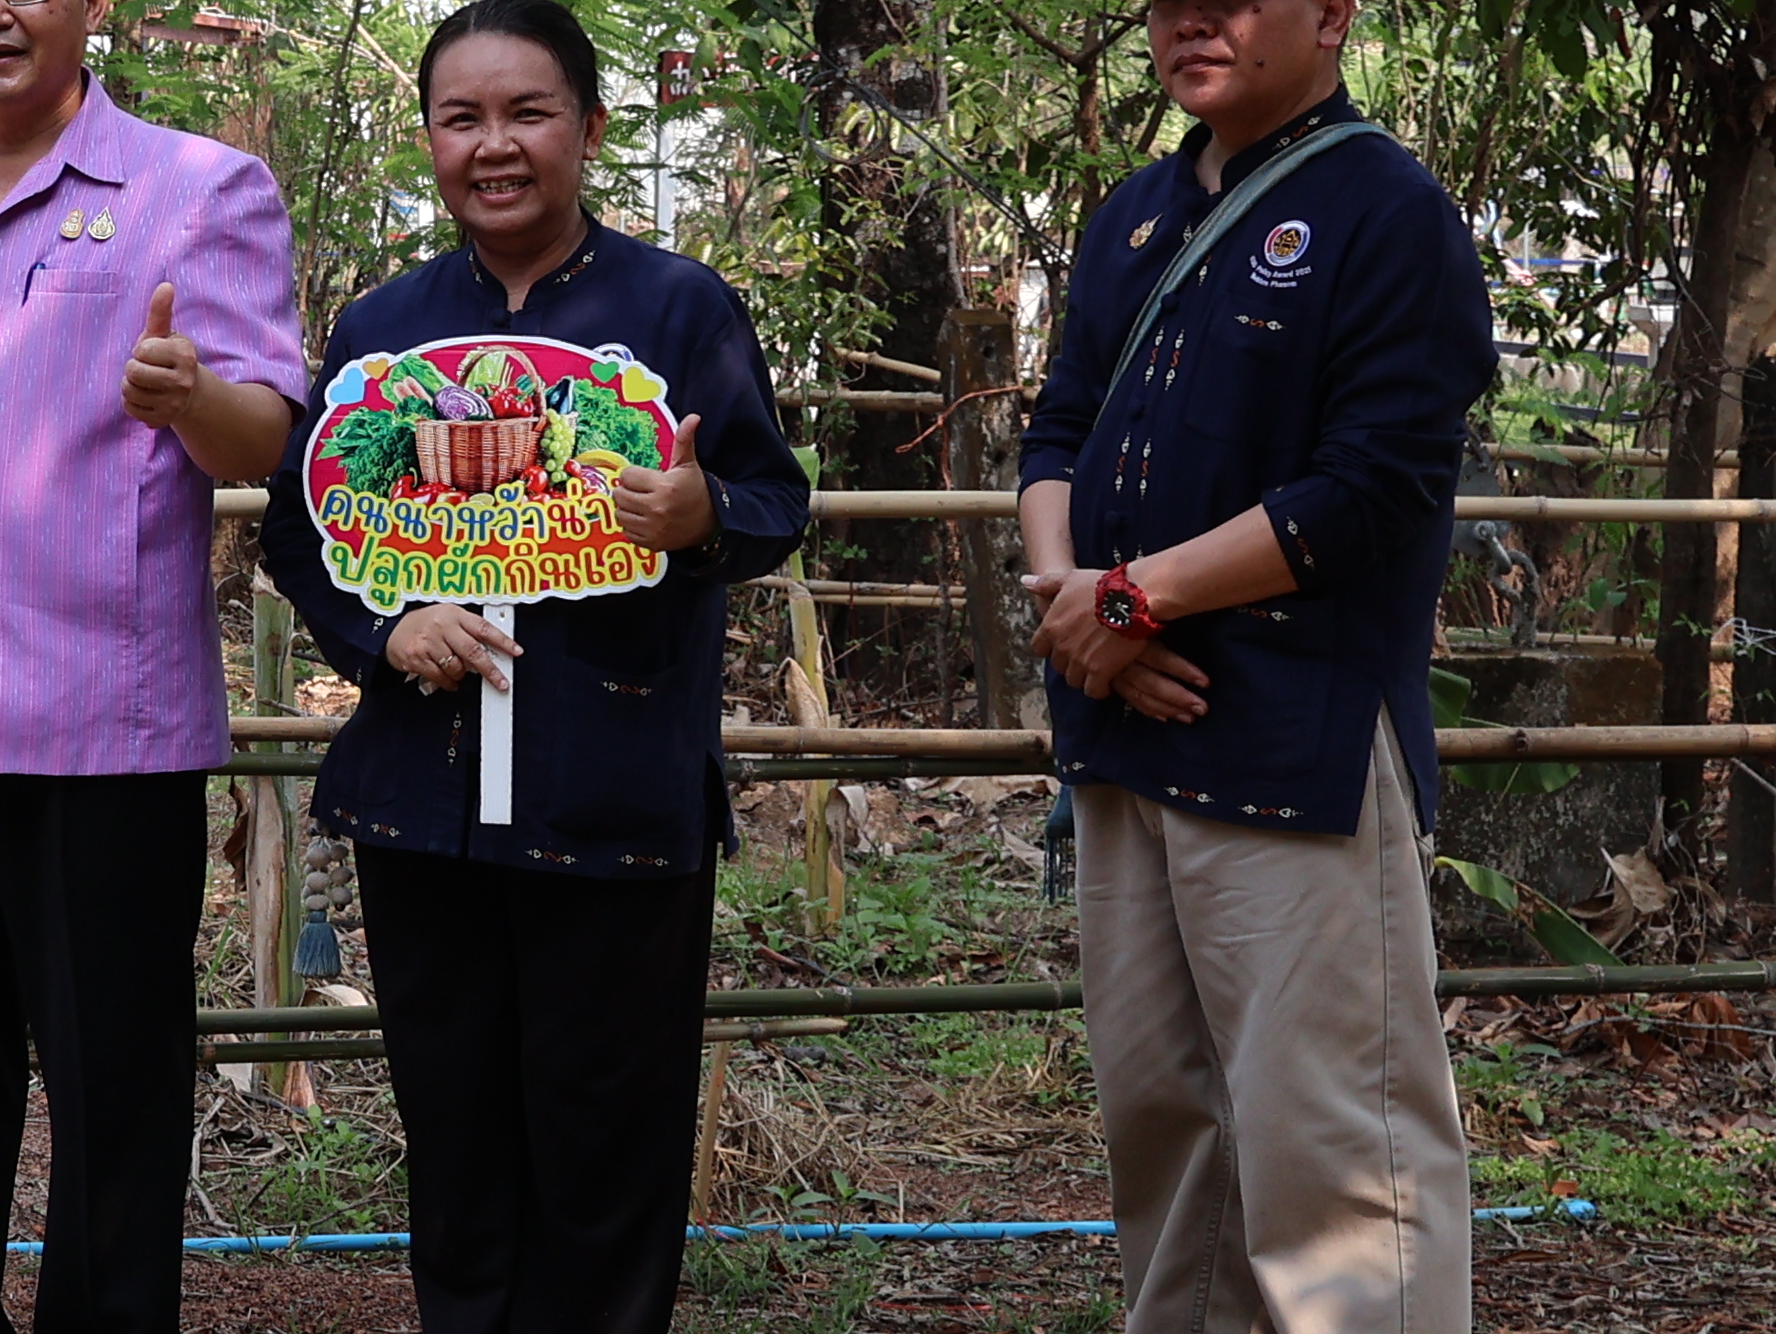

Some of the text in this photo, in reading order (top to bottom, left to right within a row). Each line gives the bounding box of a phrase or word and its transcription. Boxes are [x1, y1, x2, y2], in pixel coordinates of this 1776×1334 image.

[330, 535, 657, 608] ปลูกผักกินเอง
